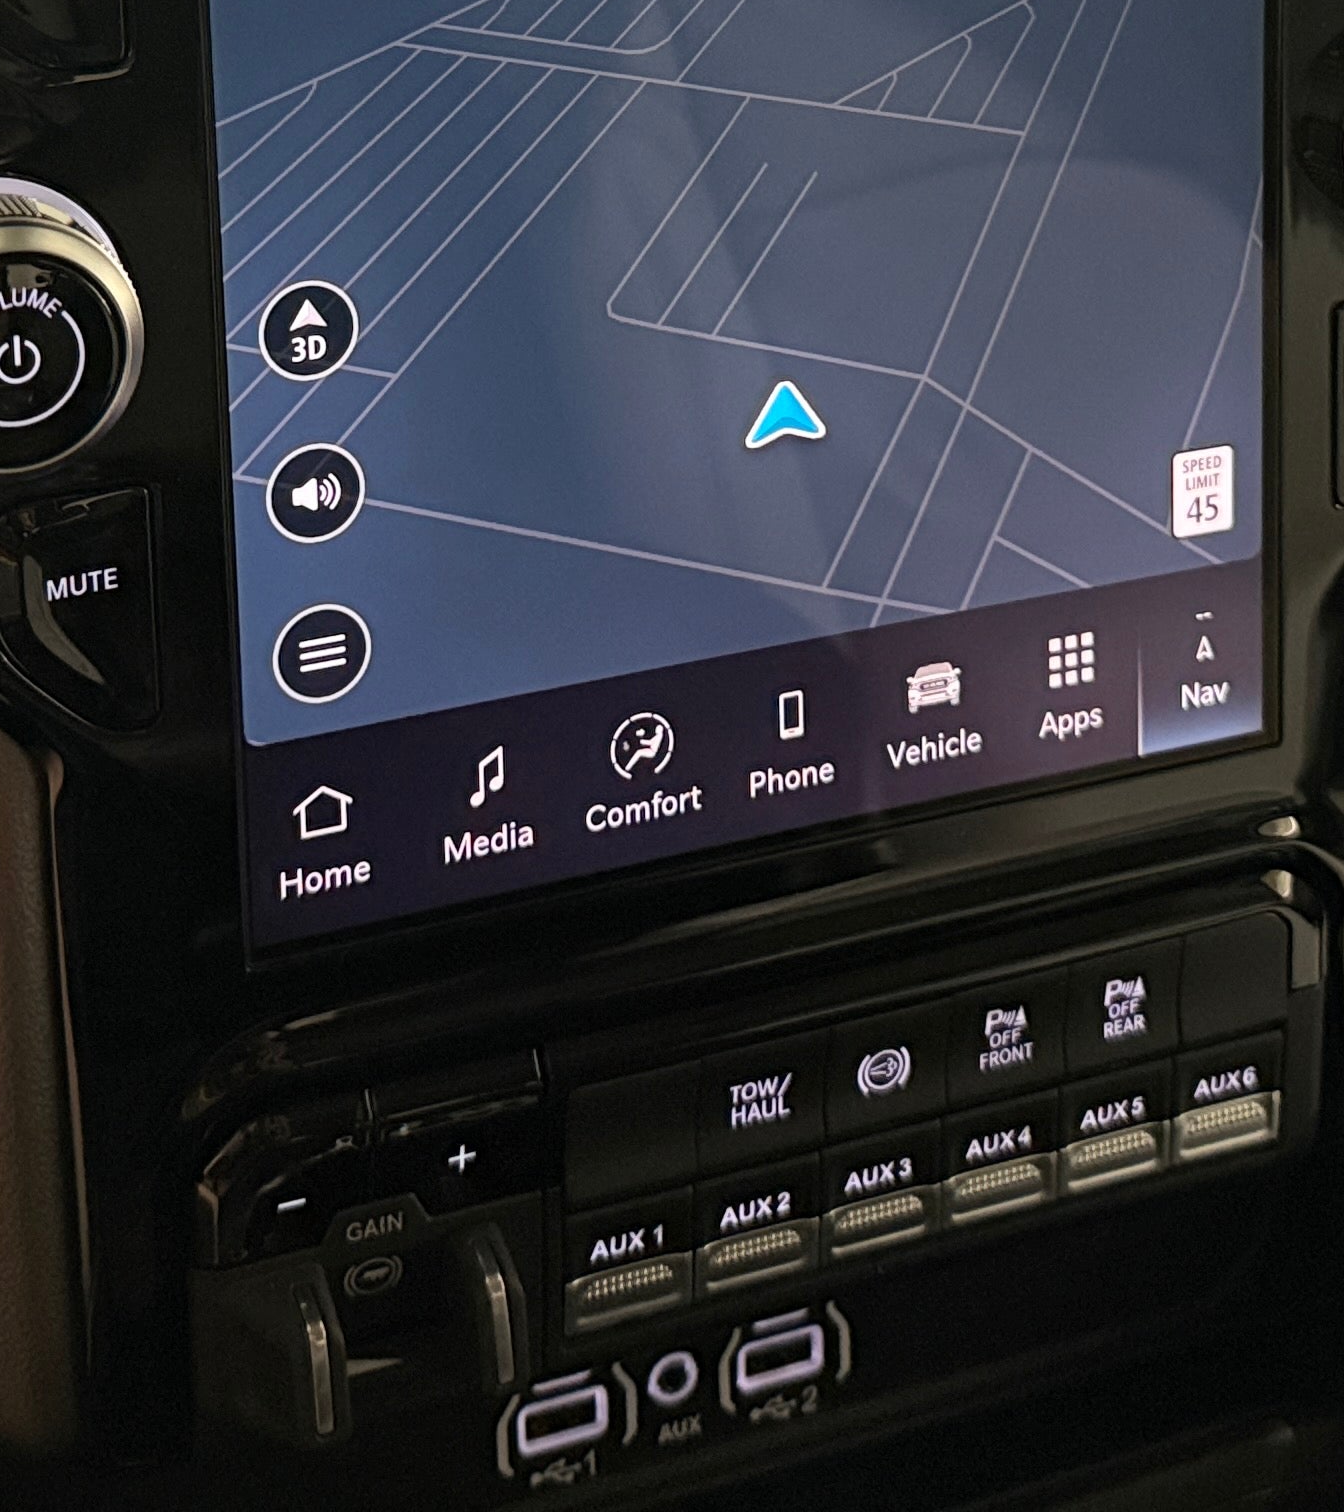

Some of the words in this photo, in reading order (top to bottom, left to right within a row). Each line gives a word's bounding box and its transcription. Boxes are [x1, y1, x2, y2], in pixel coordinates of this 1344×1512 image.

[290, 335, 327, 364] 3D
[1182, 455, 1222, 473] SPEED
[1185, 473, 1220, 491] LIMIT
[1186, 494, 1219, 523] 45
[46, 567, 119, 603] MUTE
[1181, 679, 1231, 711] Nav
[1038, 706, 1104, 742] Apps
[886, 728, 983, 770] Vehicle
[749, 759, 836, 800] Phone
[585, 786, 703, 834] Comfort
[443, 822, 535, 865] Media
[279, 859, 372, 901] Home
[1103, 1013, 1146, 1040] REAR
[1108, 999, 1141, 1019] OFF
[989, 1028, 1023, 1049] OFF
[979, 1041, 1034, 1073] FRONT
[729, 1072, 793, 1106] TOW/
[1193, 1069, 1242, 1101] AUX
[1242, 1065, 1257, 1089] 6
[730, 1095, 792, 1131] HAUL
[1079, 1099, 1130, 1133] AUX
[1131, 1095, 1146, 1120] 5
[965, 1130, 1016, 1163] AUX
[1017, 1125, 1033, 1149] 4
[843, 1161, 896, 1197] AUX
[899, 1158, 913, 1184] 3
[346, 1211, 405, 1242] GAIN
[719, 1194, 774, 1232] AUX
[777, 1191, 792, 1217] 2
[589, 1226, 647, 1264] AUX
[651, 1223, 665, 1248] 1
[658, 1413, 703, 1443] AUX
